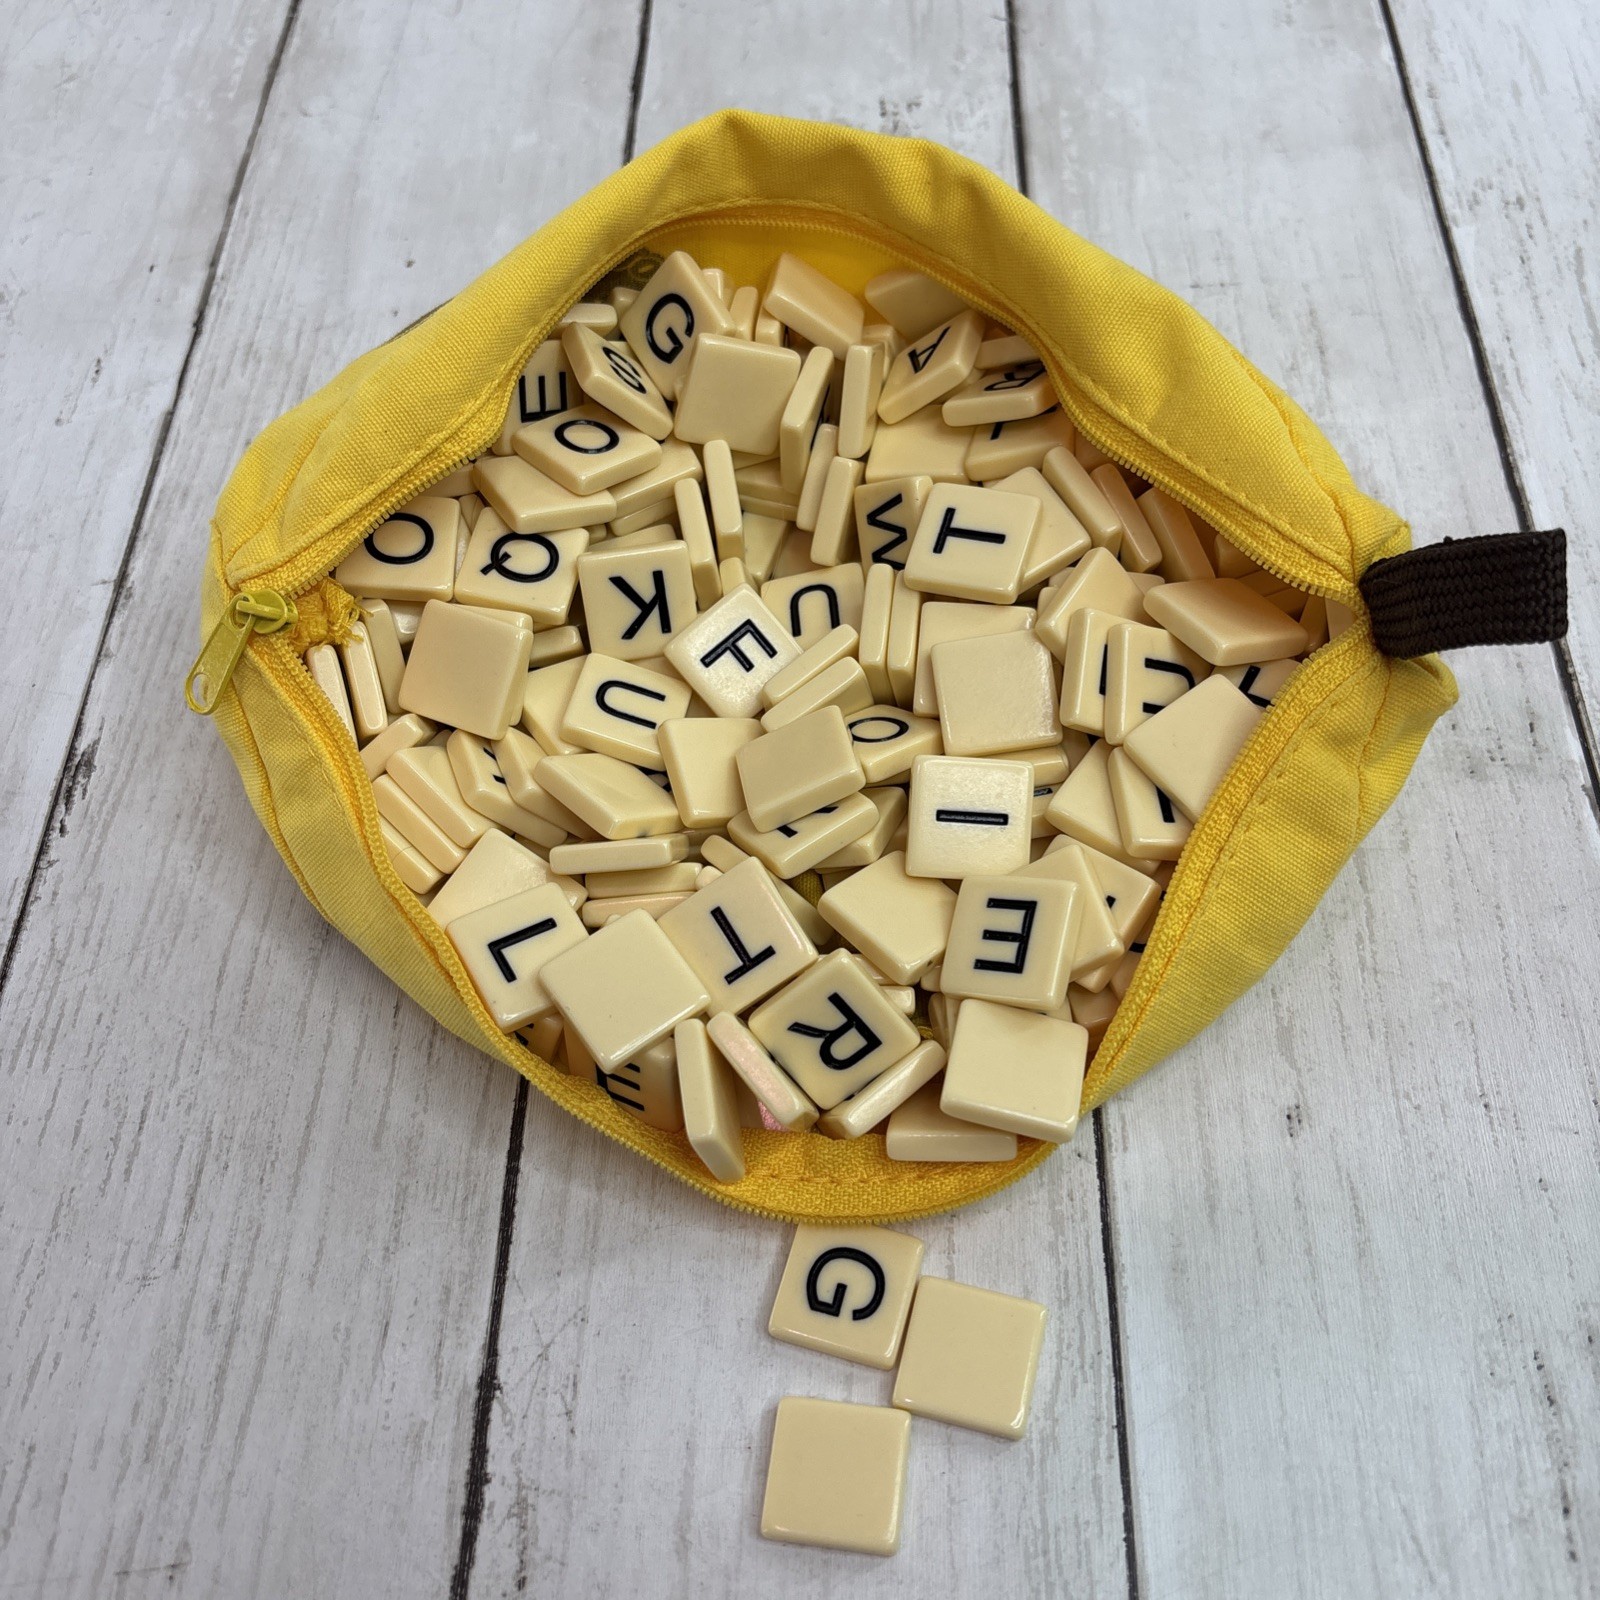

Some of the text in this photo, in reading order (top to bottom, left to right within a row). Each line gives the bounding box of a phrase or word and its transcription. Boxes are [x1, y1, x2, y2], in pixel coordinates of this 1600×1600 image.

[646, 293, 694, 364] G
[908, 326, 951, 374] A
[602, 347, 647, 394] S
[519, 372, 567, 423] E
[554, 419, 620, 454] O
[364, 512, 434, 565] O
[932, 507, 1006, 554] T
[480, 532, 559, 583] Q
[608, 569, 672, 640] K
[789, 583, 841, 637] U
[700, 618, 778, 673] F
[595, 680, 666, 730] U
[848, 716, 909, 743] O
[936, 809, 1009, 826] I
[487, 917, 557, 983] L
[710, 905, 776, 985] T
[973, 898, 1037, 974] E
[787, 991, 882, 1070] R
[806, 1246, 885, 1321] G
